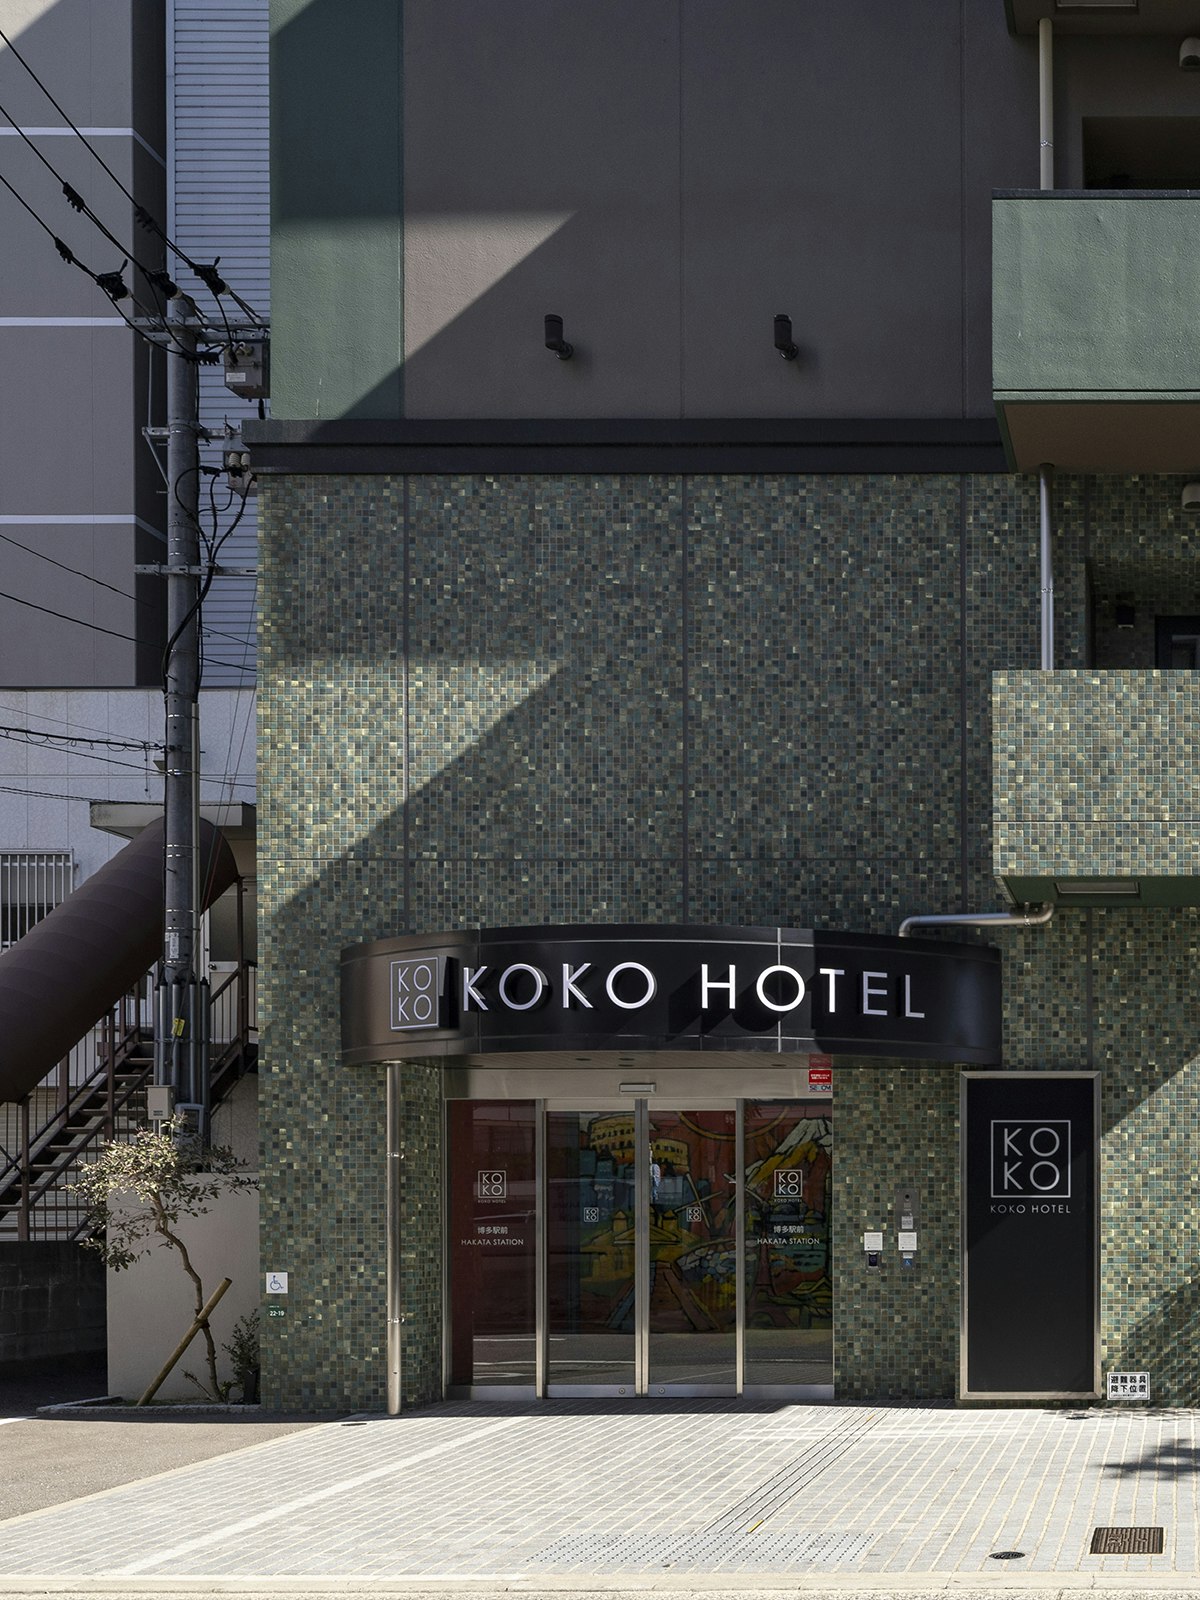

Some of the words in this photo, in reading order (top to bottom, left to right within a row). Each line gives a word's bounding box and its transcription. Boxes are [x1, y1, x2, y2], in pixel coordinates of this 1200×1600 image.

[398, 965, 432, 992] KO
[463, 962, 657, 1011] KOKO
[701, 963, 925, 1018] HOTEL
[398, 994, 432, 1021] KO
[1004, 1127, 1060, 1157] KO
[482, 1173, 503, 1184] KO
[778, 1172, 799, 1183] KO
[1004, 1160, 1060, 1190] KO
[482, 1184, 503, 1195] KO
[778, 1184, 799, 1195] KO
[990, 1204, 1026, 1214] KOKO
[1031, 1204, 1071, 1214] HOTEL
[477, 1226, 508, 1234] 博多駅前
[774, 1225, 804, 1234] 博多駅前
